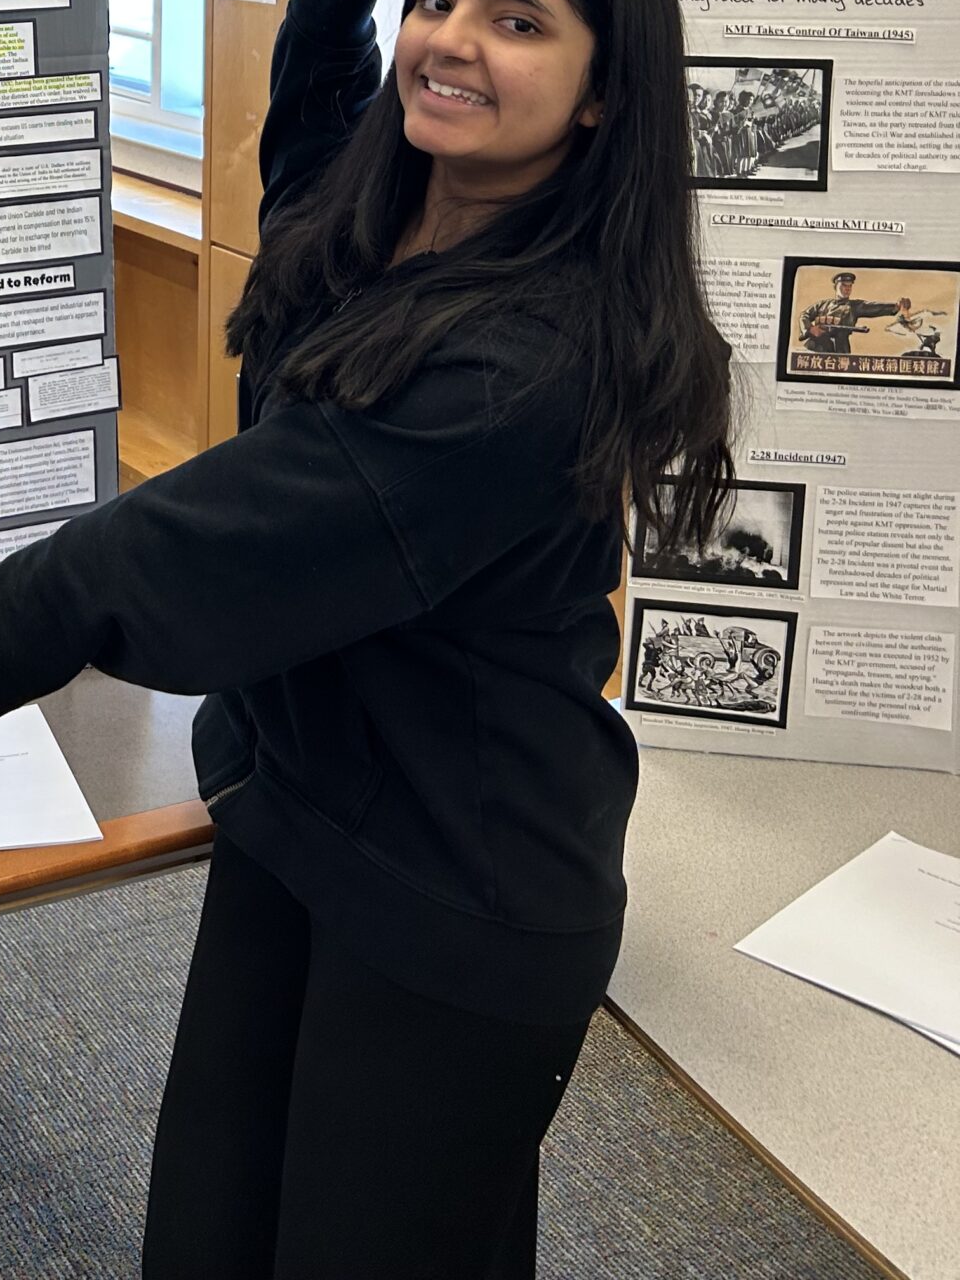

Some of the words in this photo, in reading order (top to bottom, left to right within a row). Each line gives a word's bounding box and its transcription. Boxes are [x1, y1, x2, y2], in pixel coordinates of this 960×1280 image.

[725, 25, 753, 35] KMT
[756, 25, 785, 34] Takes
[788, 26, 825, 36] Control
[828, 27, 843, 37] Of
[845, 28, 880, 38] Taiwan
[883, 29, 914, 40] (1945)
[712, 214, 735, 224] CCP
[740, 215, 798, 227] Propaganda
[802, 218, 838, 229] Against
[843, 219, 870, 230] KMT
[872, 221, 904, 232] (1947)
[7, 278, 20, 288] to
[24, 274, 70, 286] Reform
[750, 451, 771, 460] 2-28
[774, 452, 814, 462] Incident
[816, 454, 846, 464] (1947)
